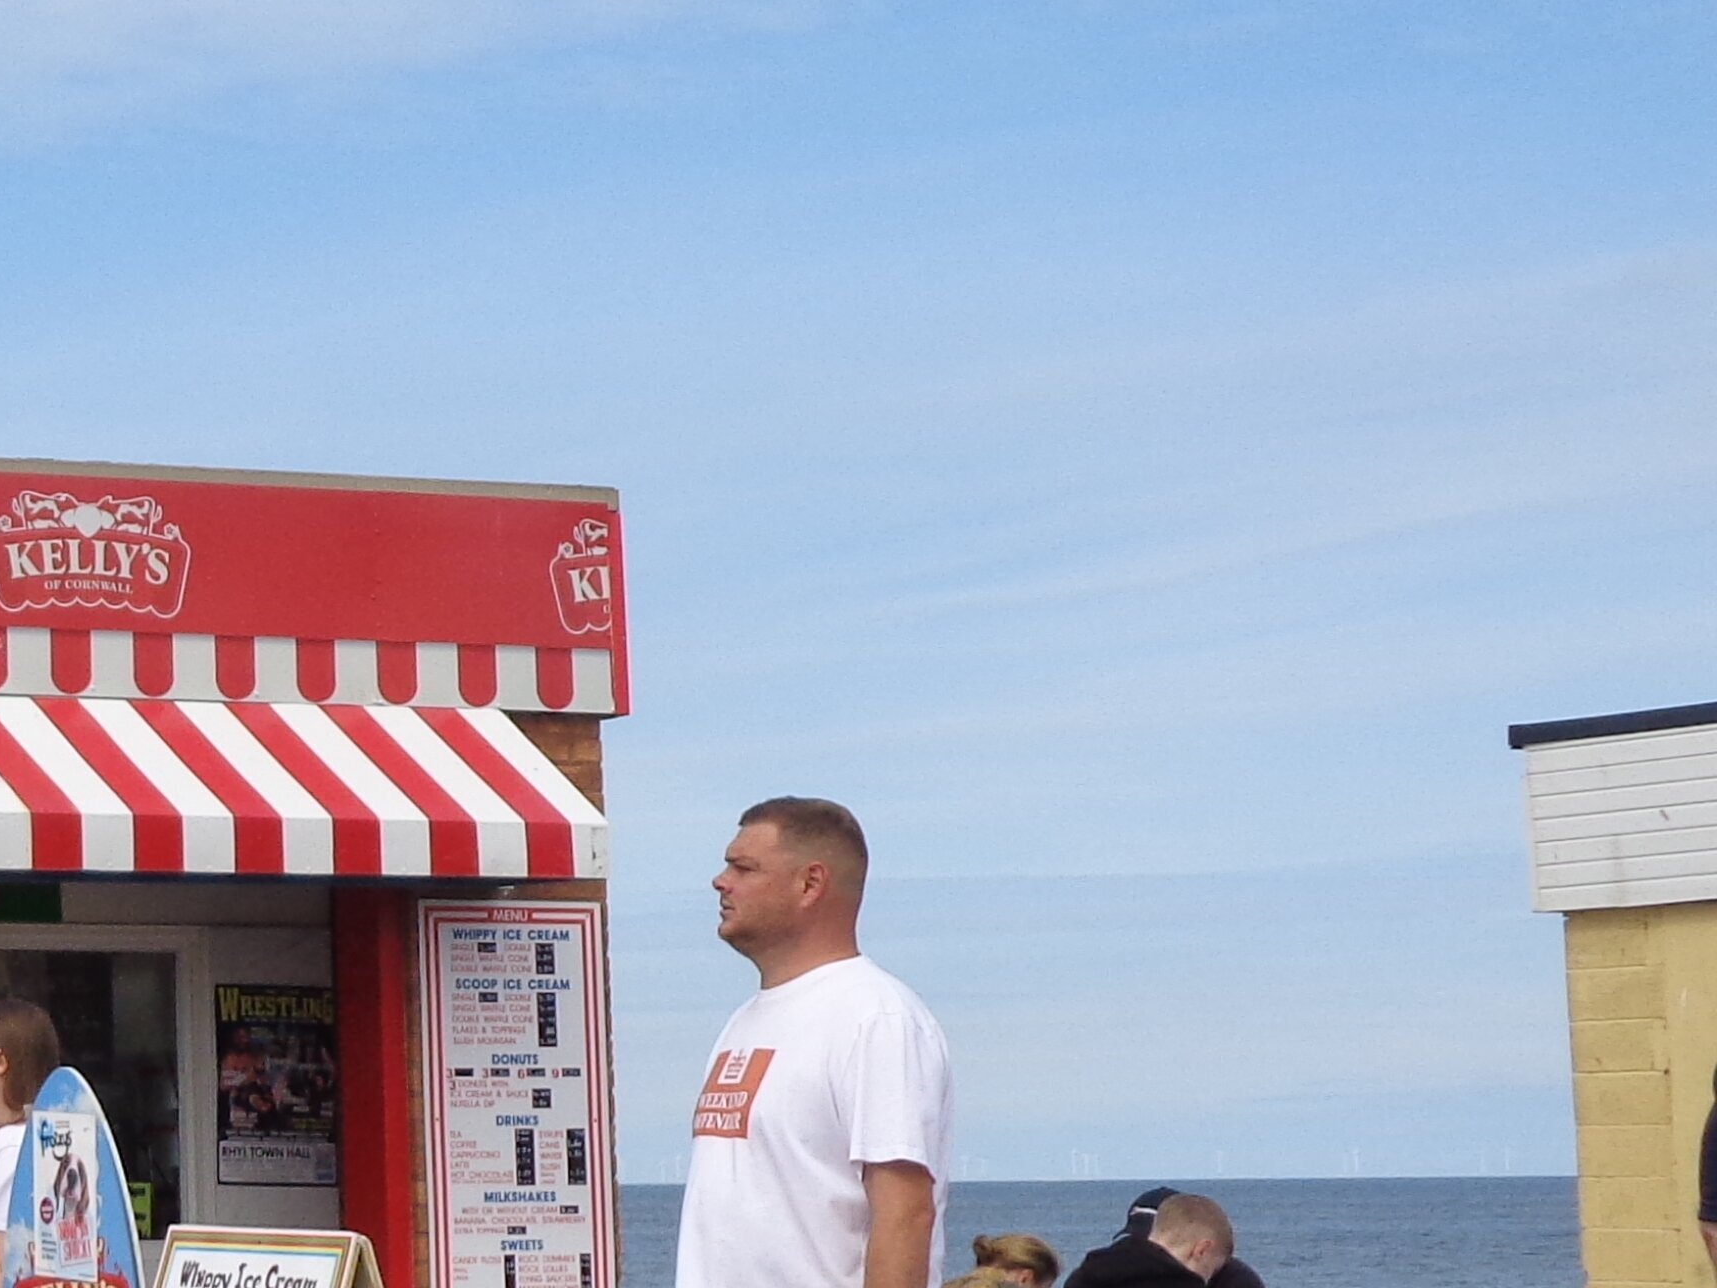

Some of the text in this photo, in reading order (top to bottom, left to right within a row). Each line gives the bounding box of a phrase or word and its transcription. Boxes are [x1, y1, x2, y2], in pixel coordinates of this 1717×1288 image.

[4, 539, 170, 585] KELLY'S
[44, 579, 134, 594] OF CORNWALL
[493, 910, 528, 921] MENU
[453, 929, 570, 940] WHIPPY ICE CREAM
[455, 979, 570, 989] SCOOP ICE CREAM
[492, 1054, 539, 1064] DONUTS
[518, 1069, 525, 1079] 6
[552, 1069, 559, 1078] 9
[496, 1115, 539, 1126] DRINKS
[250, 1146, 284, 1159] TOWN
[484, 1191, 556, 1202] MILKSHAKES
[501, 1240, 543, 1251] SWEETS
